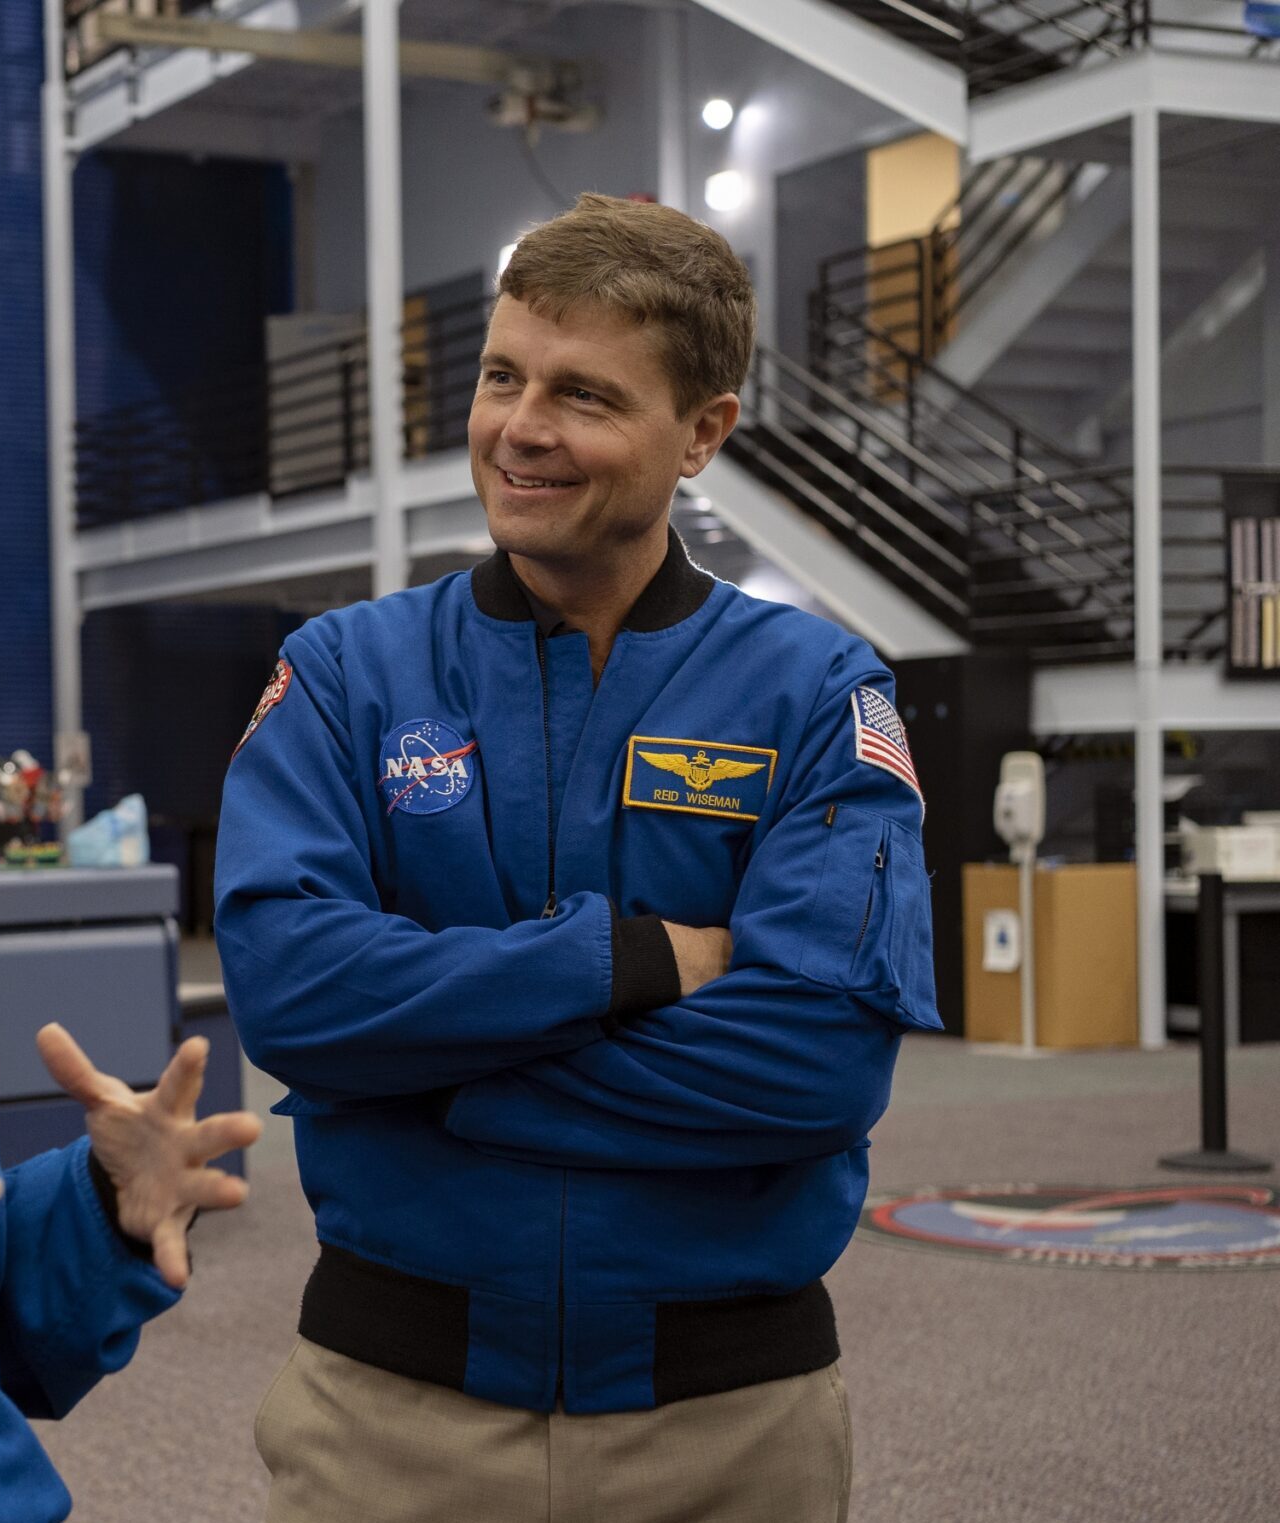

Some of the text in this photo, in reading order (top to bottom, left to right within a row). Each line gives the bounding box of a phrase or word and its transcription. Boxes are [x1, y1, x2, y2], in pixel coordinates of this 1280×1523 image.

[385, 756, 469, 778] NASA
[653, 788, 741, 809] REID WISEMAN
